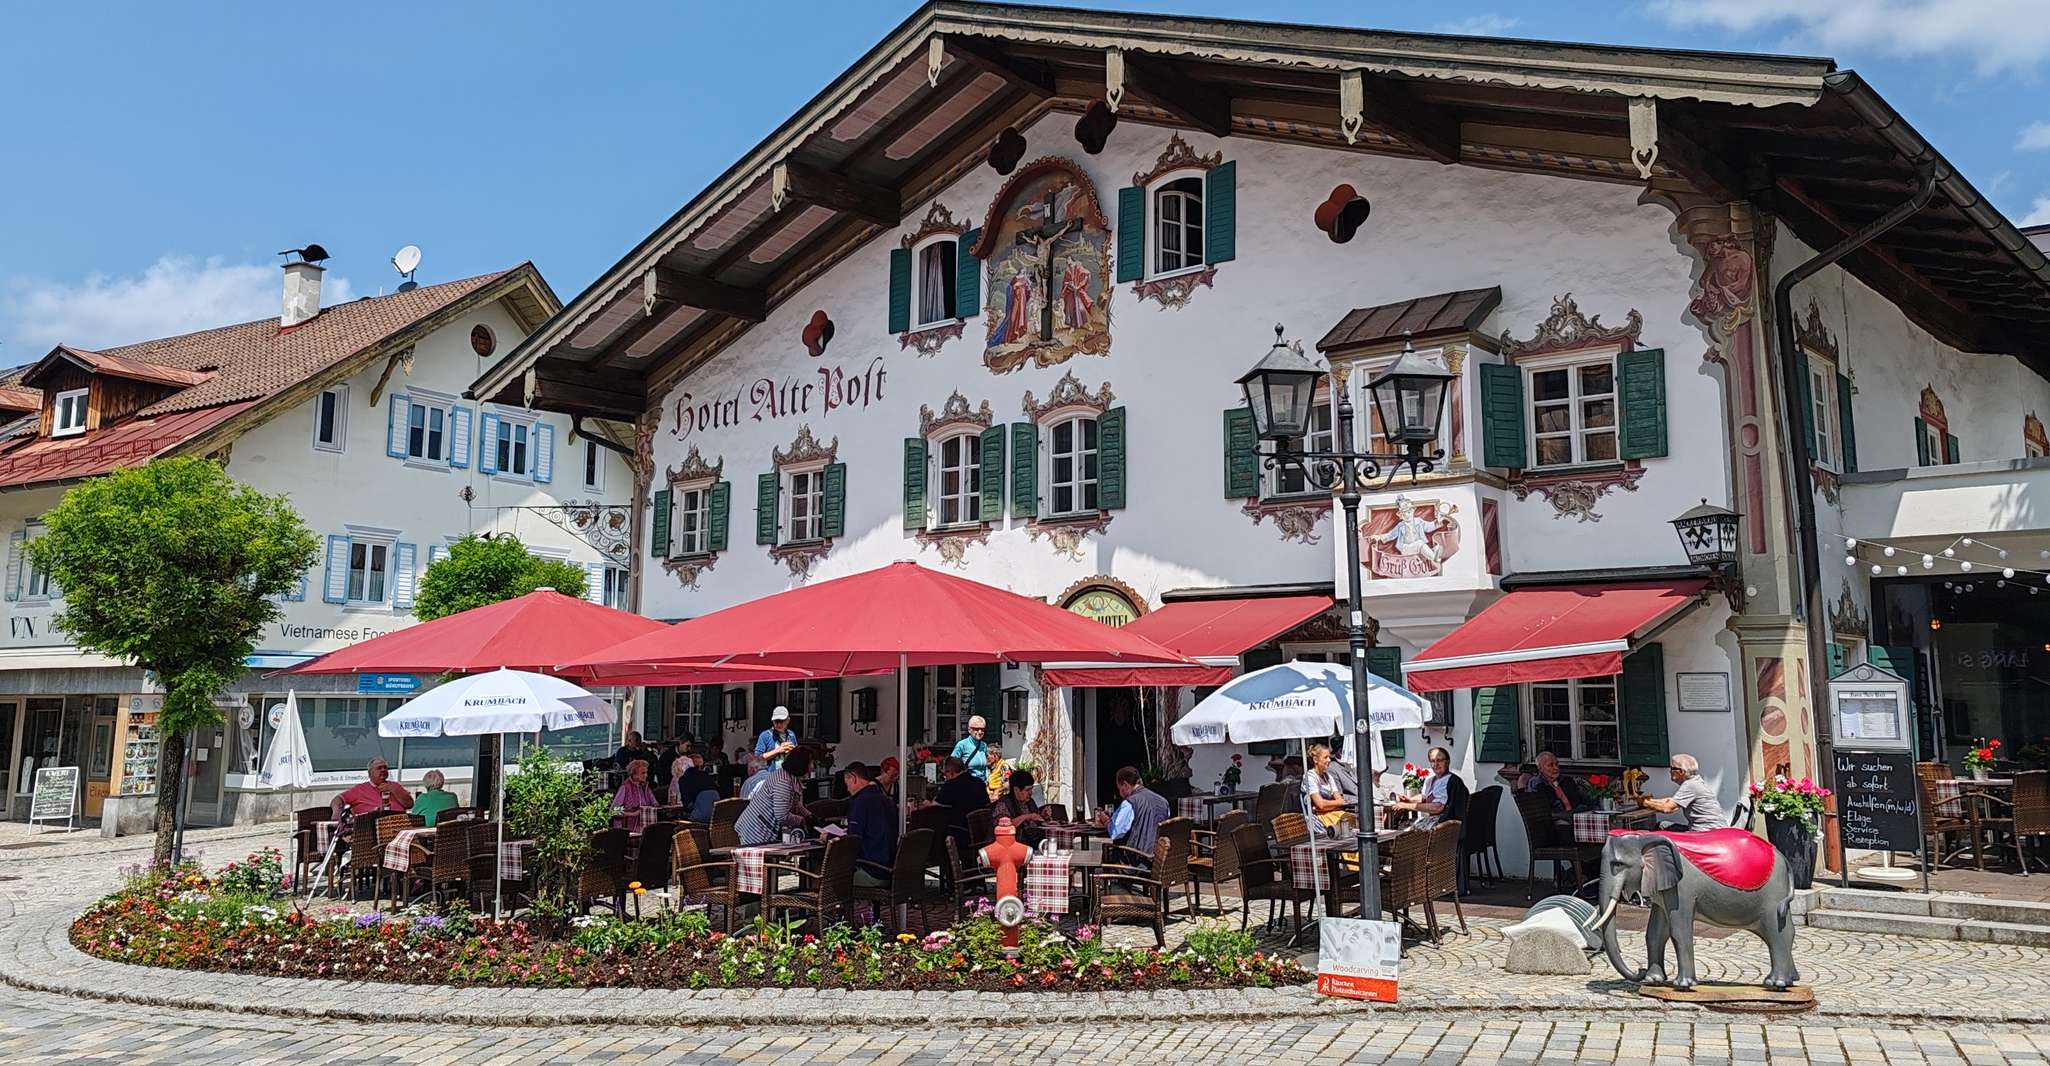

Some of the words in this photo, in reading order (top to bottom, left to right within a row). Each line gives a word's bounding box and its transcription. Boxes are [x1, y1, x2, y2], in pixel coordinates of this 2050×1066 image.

[669, 384, 744, 441] Hotel
[750, 376, 813, 422] Alte
[281, 623, 358, 640] Vietnamese
[363, 627, 394, 641] Foo
[464, 697, 526, 707] KRUMBACH
[1249, 699, 1316, 711] KRUMBACH
[1370, 711, 1395, 722] MBACH
[399, 720, 431, 731] KRUMBACH
[1837, 757, 1856, 772] Wir
[1861, 757, 1893, 772] suchen
[1846, 776, 1858, 788] ab
[1862, 775, 1888, 791] sofort
[1332, 964, 1379, 977] Woodcarving
